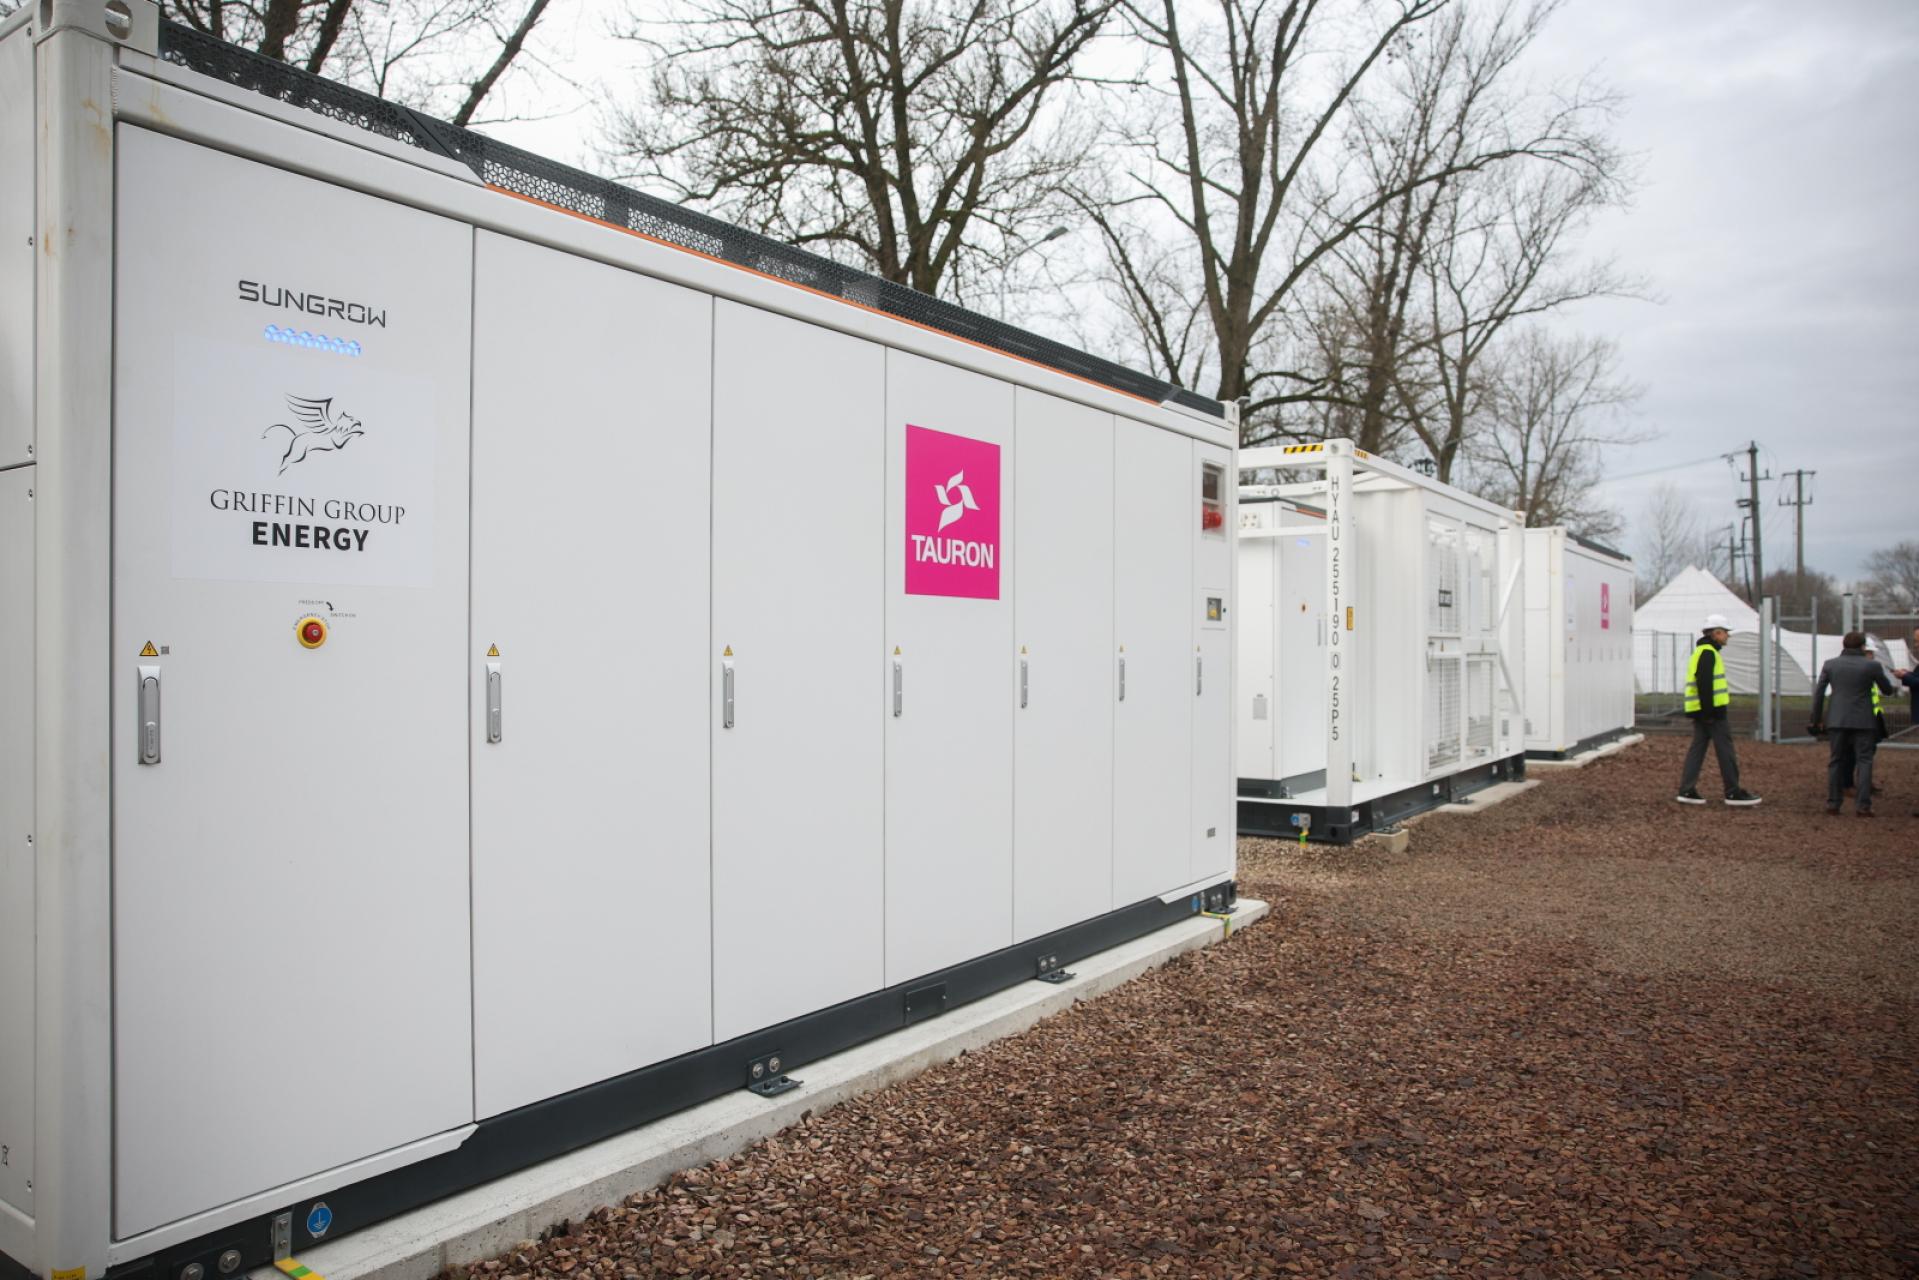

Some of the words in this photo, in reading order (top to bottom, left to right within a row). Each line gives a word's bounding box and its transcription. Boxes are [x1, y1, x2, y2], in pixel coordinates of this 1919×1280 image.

[238, 280, 386, 328] SUNGROW
[210, 489, 315, 517] GRIFFIN
[324, 499, 405, 524] GROUP
[1331, 475, 1340, 541] HYAU
[252, 521, 369, 551] ENERGY
[911, 534, 994, 569] TAURON
[1331, 547, 1340, 646] 255190
